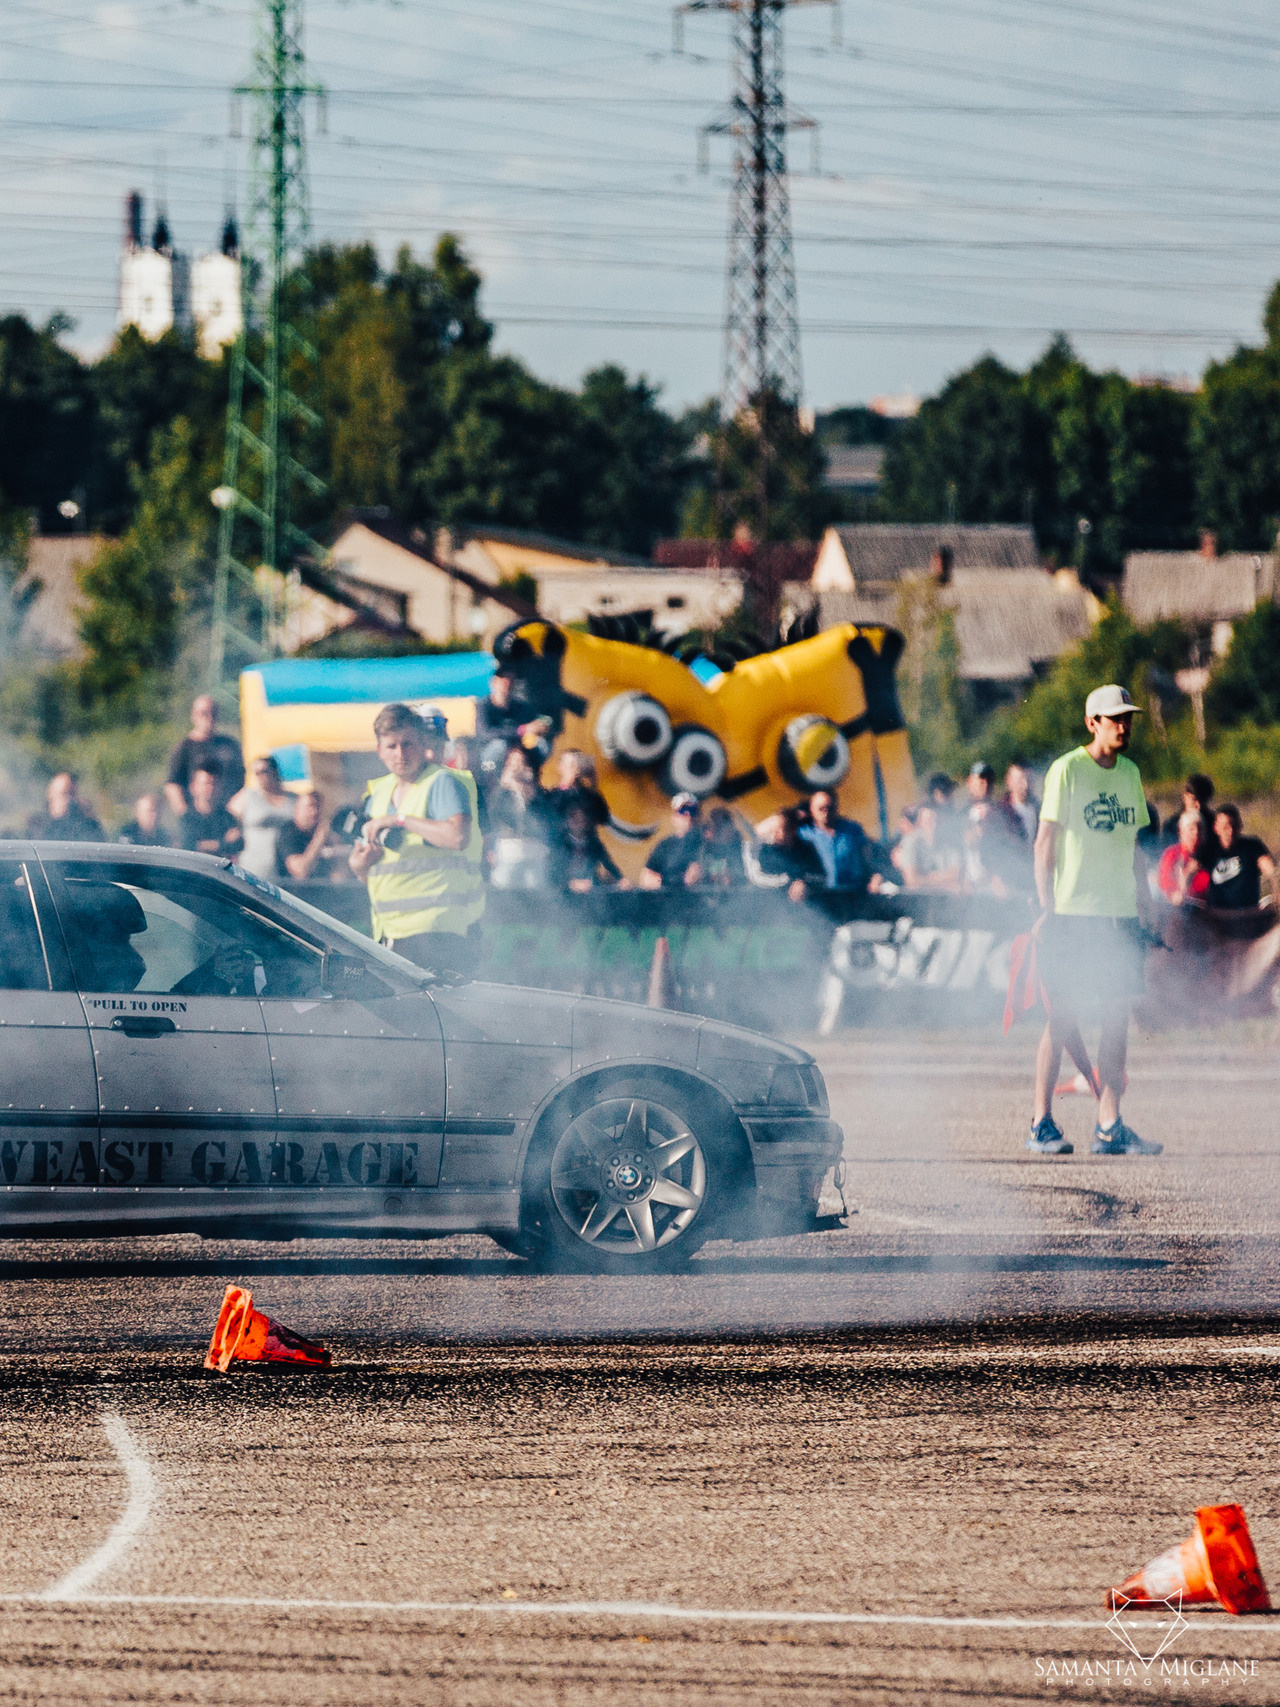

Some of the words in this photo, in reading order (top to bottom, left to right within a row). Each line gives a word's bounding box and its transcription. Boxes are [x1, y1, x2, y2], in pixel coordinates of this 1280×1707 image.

[93, 1000, 126, 1011] PULL
[130, 1001, 148, 1012] TO
[151, 1002, 188, 1013] OPEN
[191, 1140, 419, 1185] GARAGE
